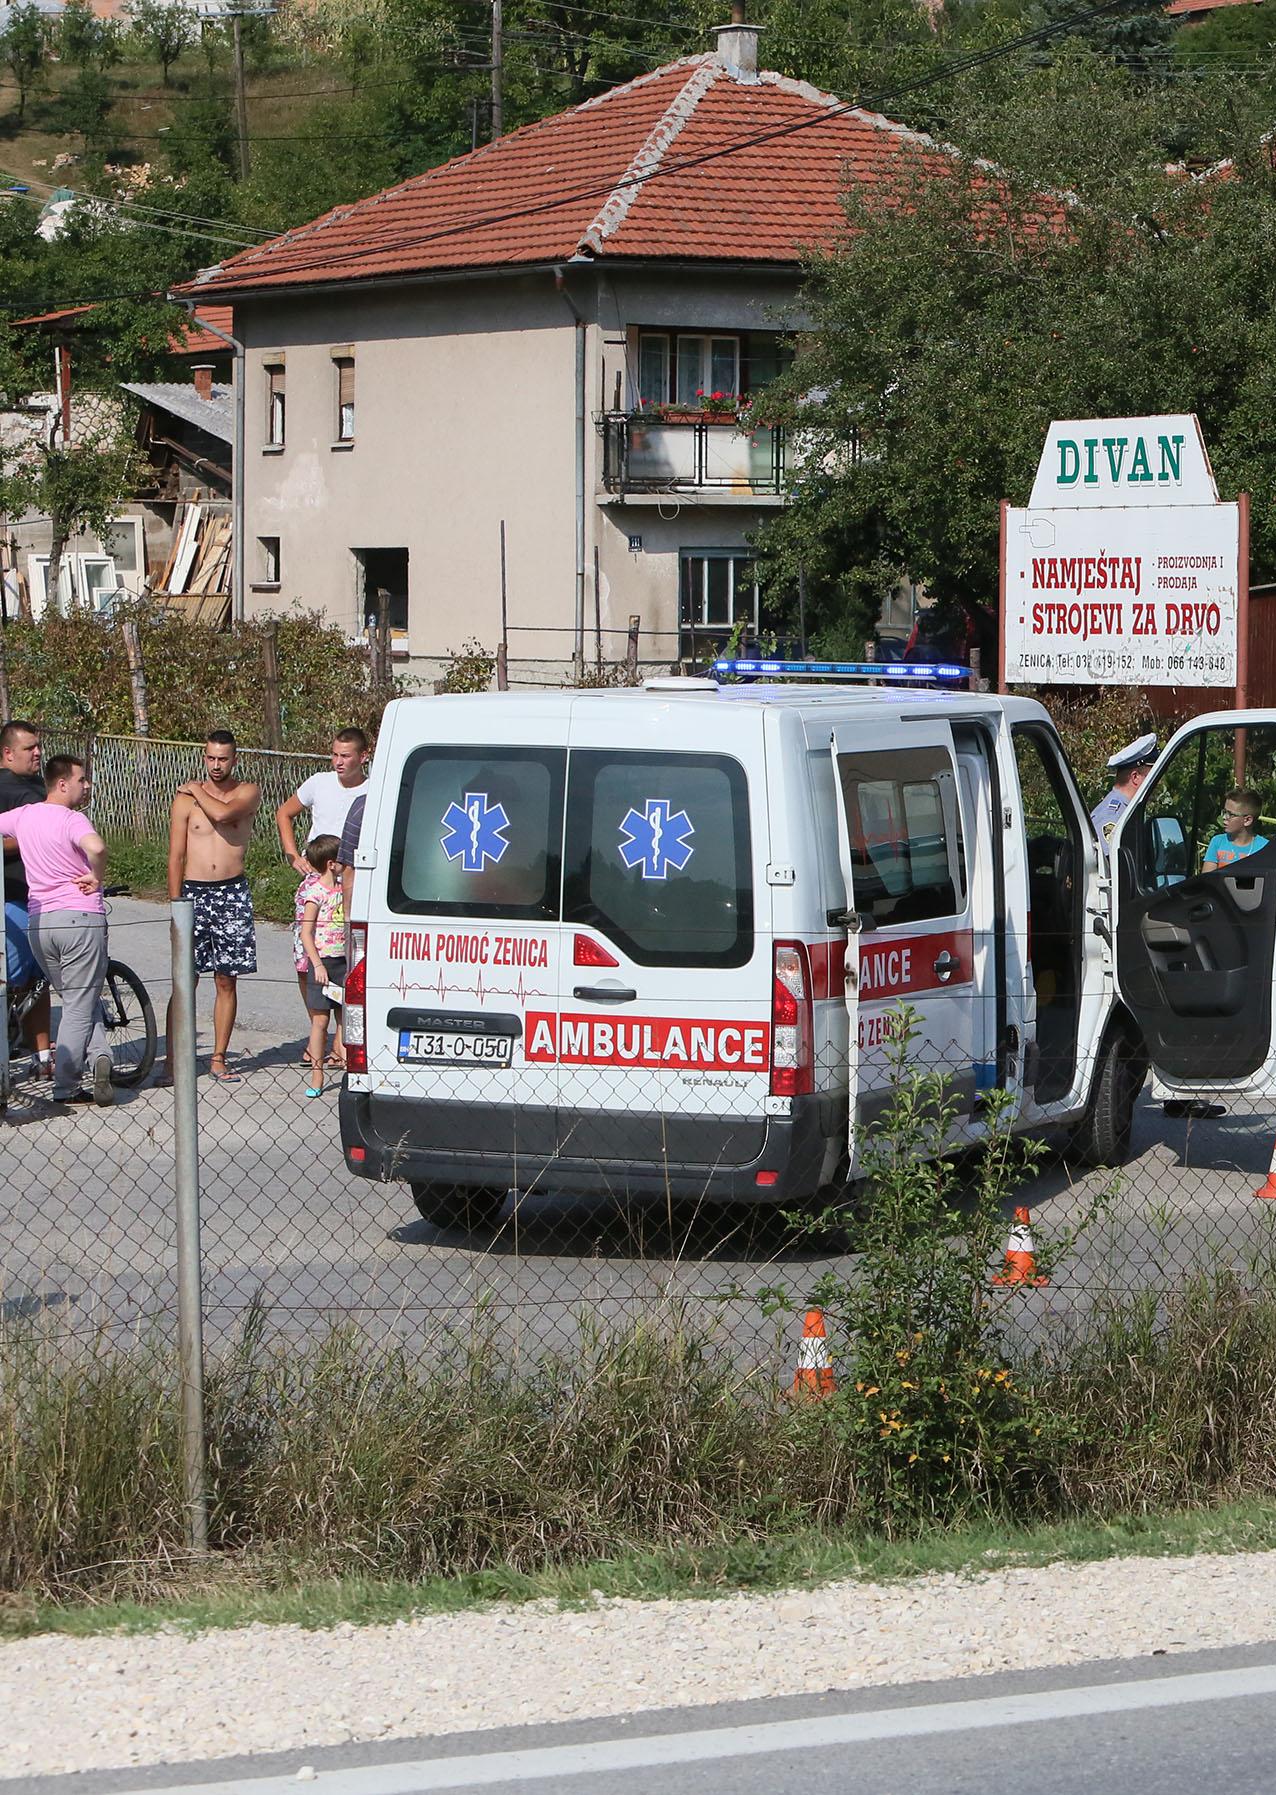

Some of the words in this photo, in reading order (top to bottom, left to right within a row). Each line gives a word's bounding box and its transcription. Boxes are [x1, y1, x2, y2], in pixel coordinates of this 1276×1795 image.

[1056, 435, 1186, 487] DIVAN
[1032, 549, 1142, 596] NAMJEŠTAJ
[1157, 556, 1217, 571] PROIZVODNJA
[1219, 556, 1224, 569] I
[1157, 576, 1198, 591] PRODAJA
[1032, 602, 1123, 642] STROJEVI
[1132, 603, 1158, 635] ZA
[1165, 602, 1221, 636] DRVO
[1019, 654, 1055, 668] ZENICA:
[1142, 656, 1164, 670] Mob:
[1167, 656, 1185, 670] 066
[1188, 656, 1226, 671] 143-848
[389, 932, 431, 961] HITNA
[435, 931, 490, 965] POMOĆ
[493, 937, 549, 968] ZENICA
[417, 1016, 486, 1030] MASTER
[529, 1019, 769, 1065] AMBULANCE
[682, 1077, 750, 1089] RENAULT
